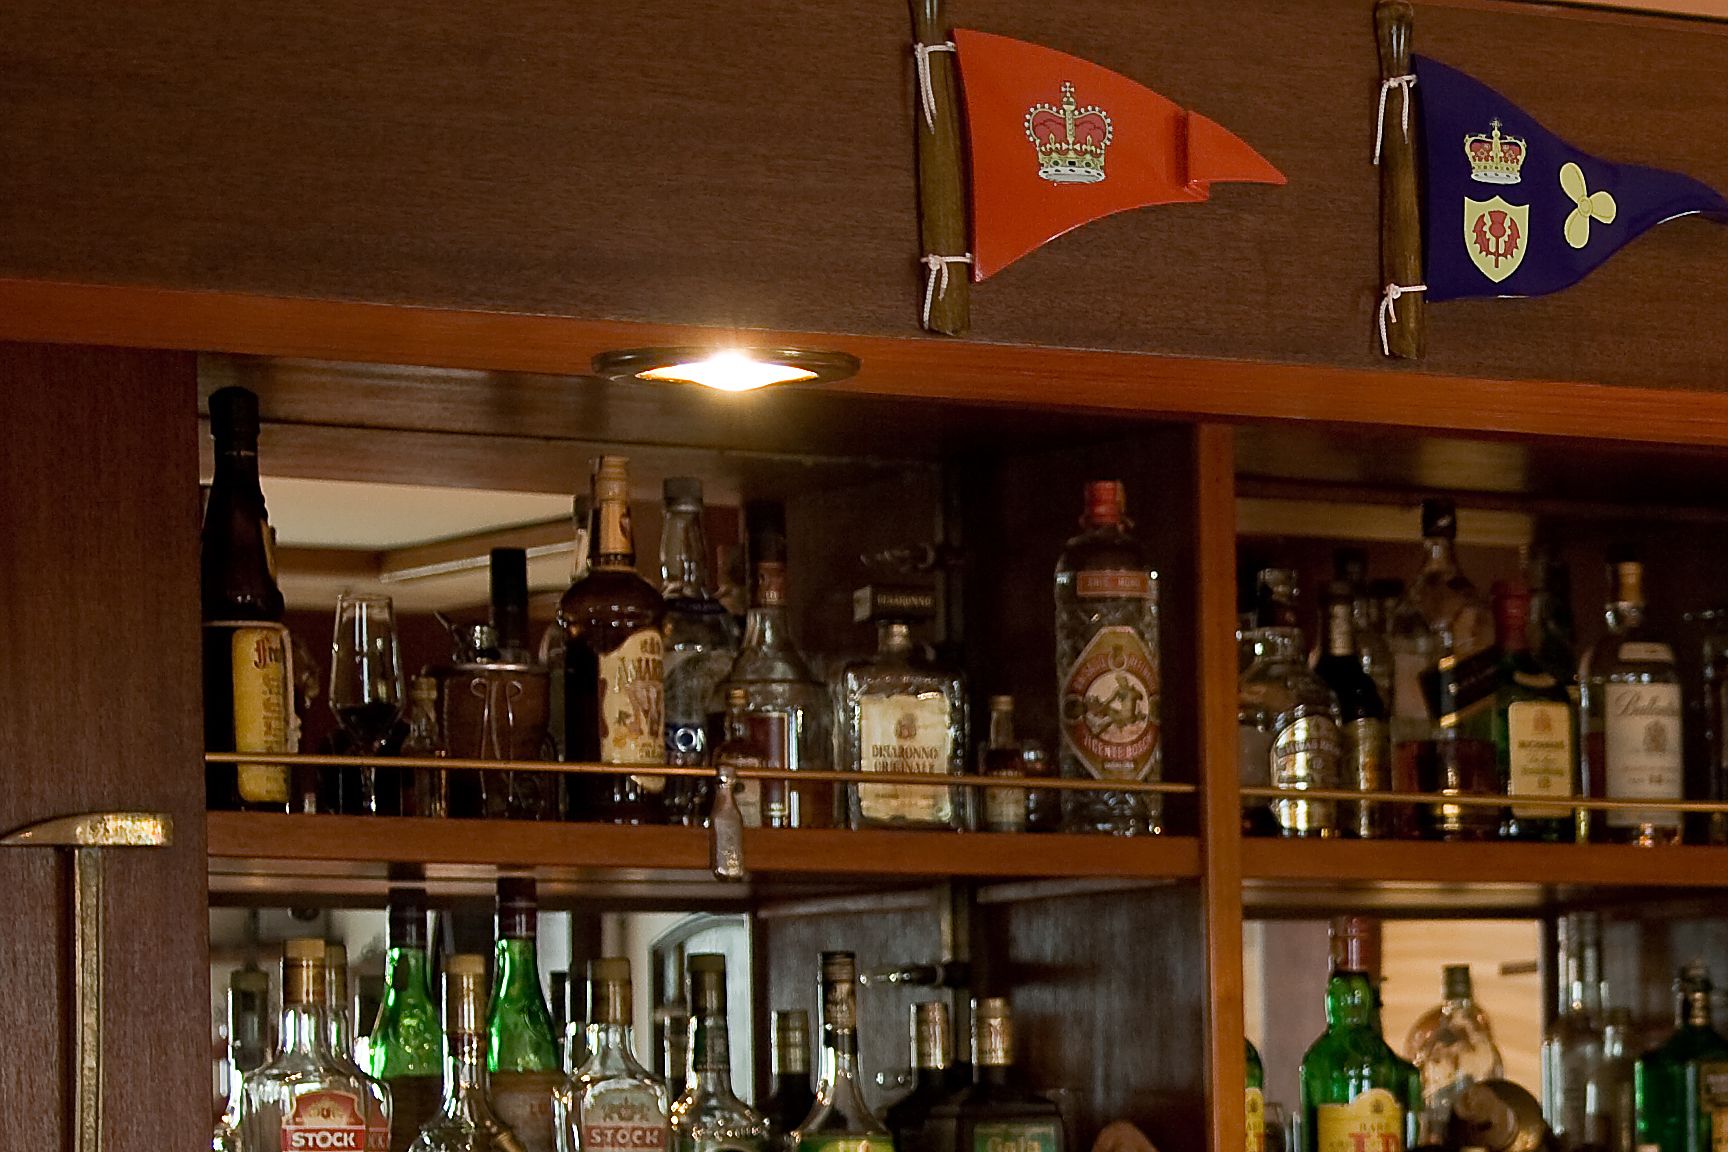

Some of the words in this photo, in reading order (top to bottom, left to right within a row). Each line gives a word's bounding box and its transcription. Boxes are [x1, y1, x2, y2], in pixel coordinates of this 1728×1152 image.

[872, 745, 939, 760] DISARONNO
[291, 1131, 356, 1149] STOCK
[590, 1128, 659, 1145] STOCK
